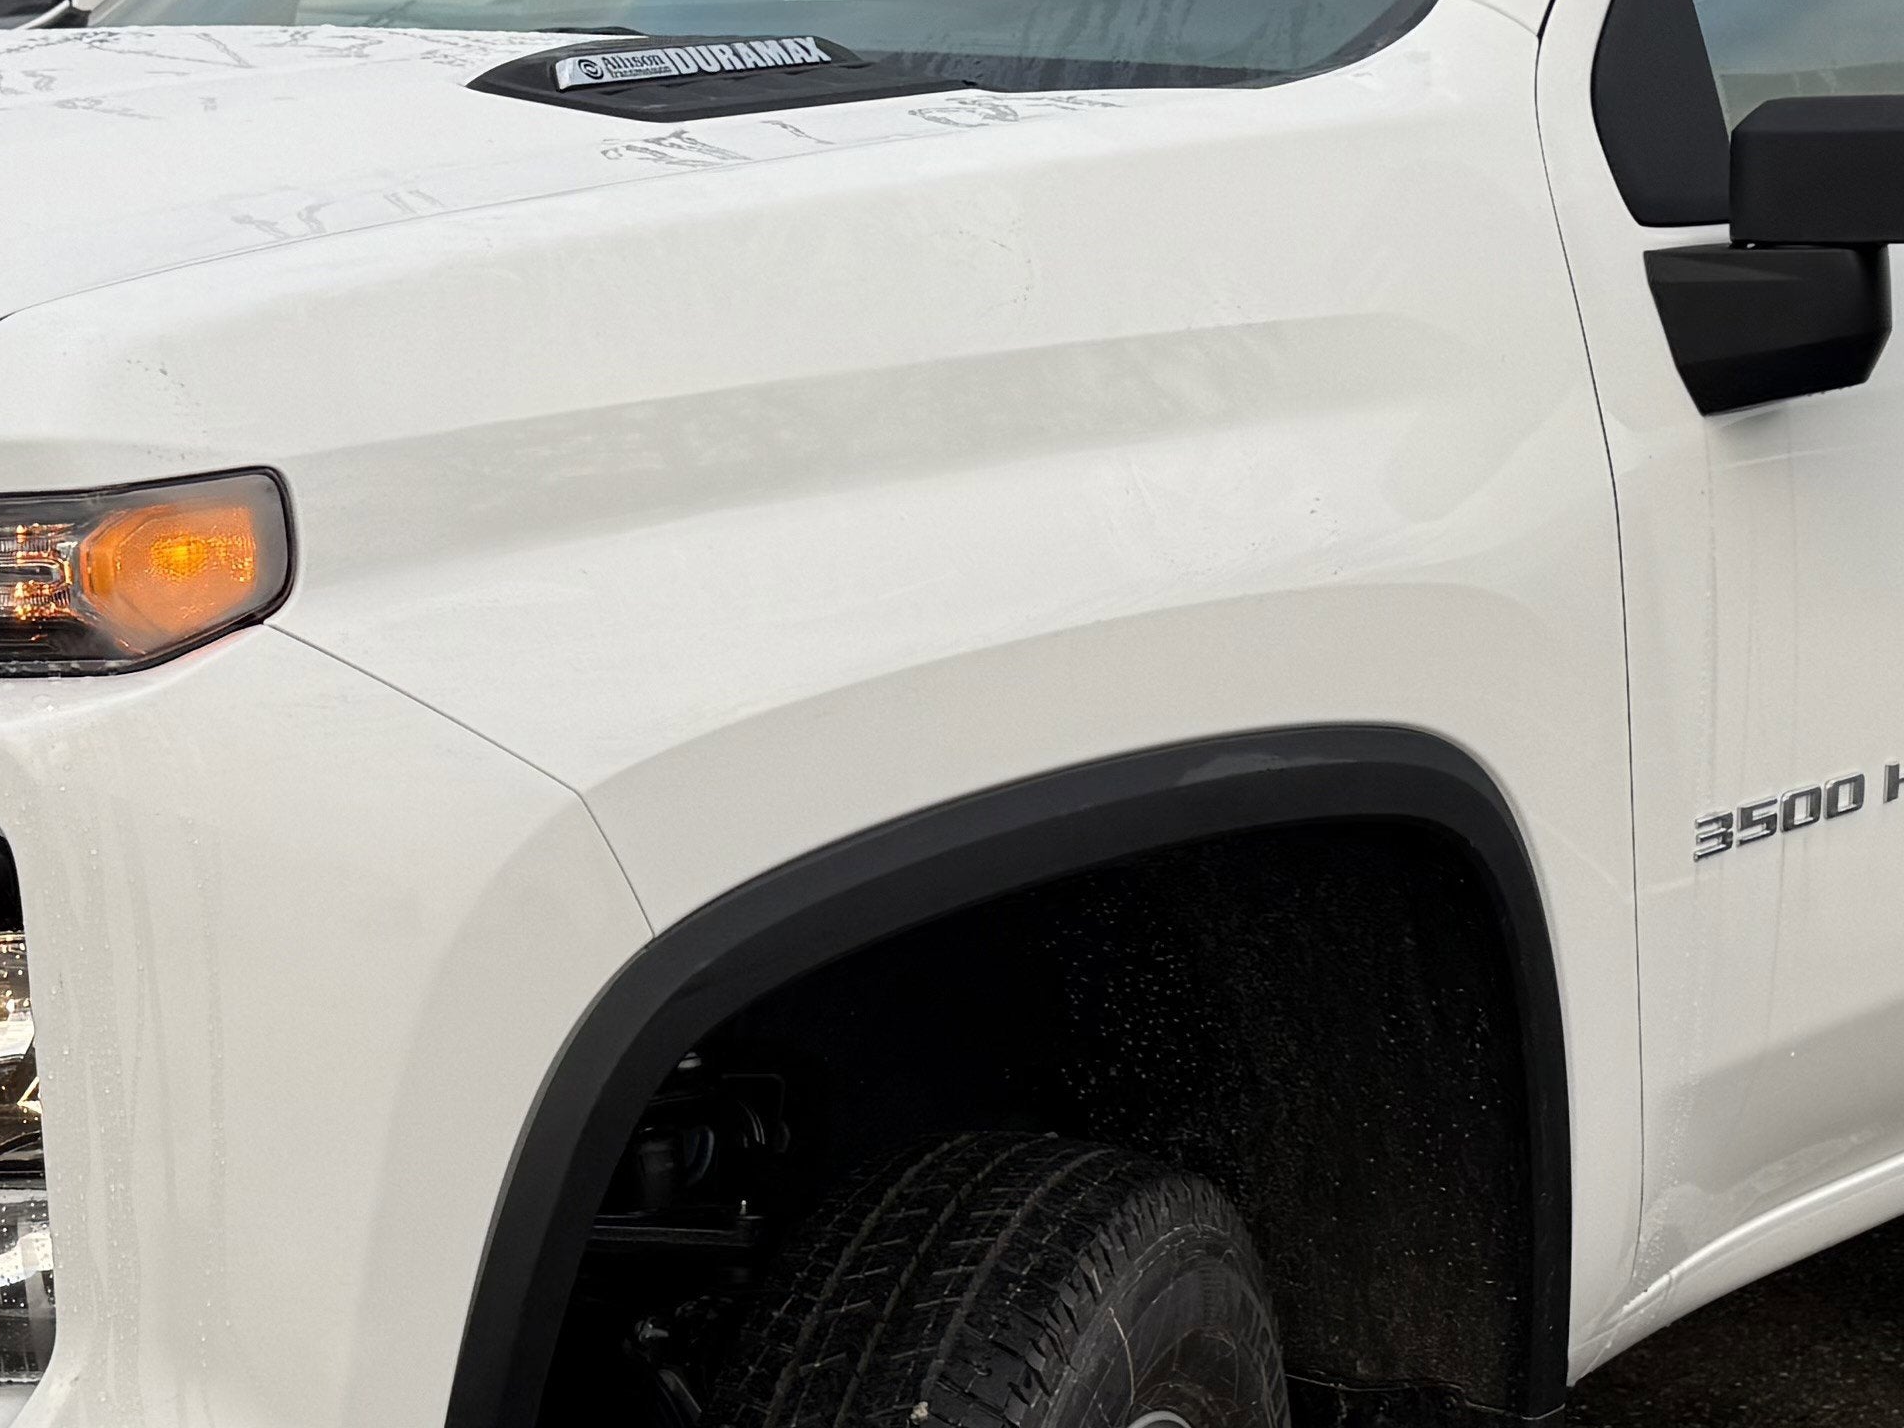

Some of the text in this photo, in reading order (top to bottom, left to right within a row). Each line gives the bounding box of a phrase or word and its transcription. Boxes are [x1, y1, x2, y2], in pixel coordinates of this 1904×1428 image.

[601, 36, 832, 75] Allison DURAMAX
[1693, 772, 1865, 862] 3500
